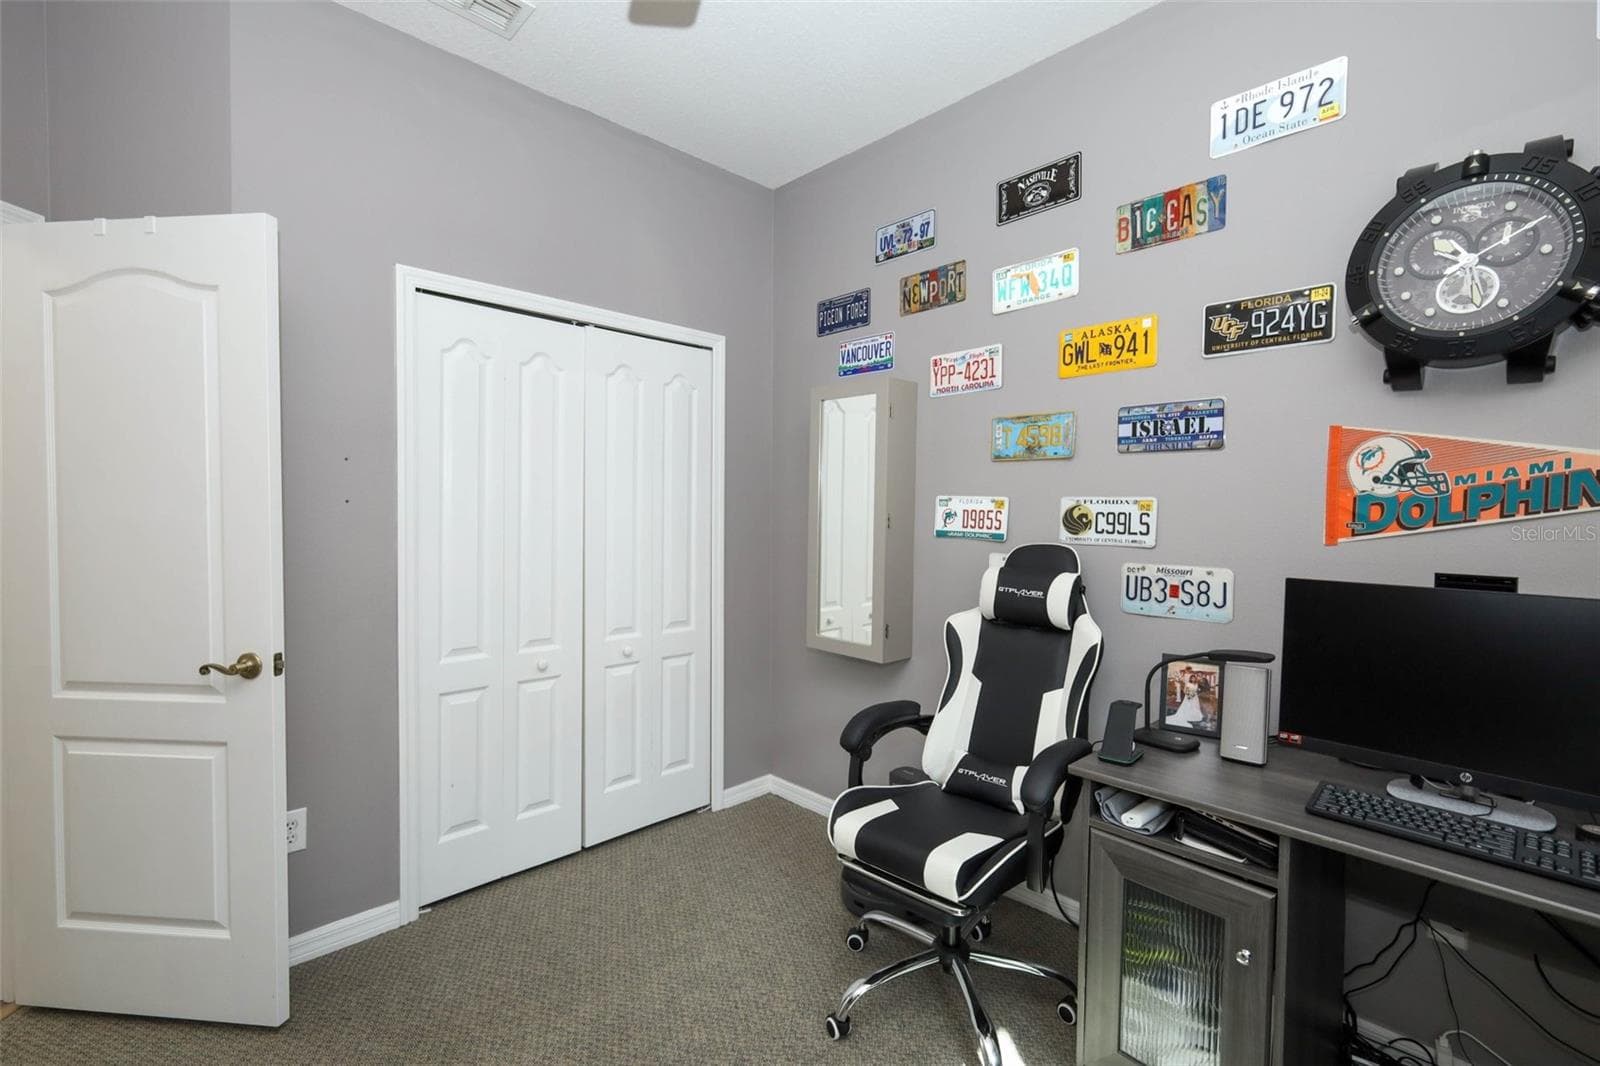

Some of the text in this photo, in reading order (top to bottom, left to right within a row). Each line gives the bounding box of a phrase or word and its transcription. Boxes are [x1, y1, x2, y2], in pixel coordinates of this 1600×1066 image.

[1241, 69, 1312, 104] Rhode Island
[1280, 77, 1334, 118] 972
[1243, 118, 1307, 145] Ocean State
[1017, 168, 1058, 196] NASHVILLE
[1166, 188, 1225, 232] EASY
[902, 271, 964, 311] NEWPORT
[1240, 294, 1293, 310] FLORIDA
[820, 307, 843, 328] PIGEON
[1210, 301, 1328, 340] UCF 924YG
[1081, 323, 1132, 340] ALASKA
[1211, 341, 1249, 352] UNIVERSITY
[1261, 335, 1290, 344] CENTRAL
[1292, 331, 1323, 340] FLORIDA
[840, 340, 892, 365] VANCOUVER
[1062, 330, 1149, 366] GWL 941
[933, 357, 996, 387] YPP-4231
[937, 380, 994, 395] NORTH CAROLINA
[1130, 416, 1211, 438] ISRAEL
[1454, 457, 1572, 487] MIAMI
[1156, 567, 1193, 576] Missouri
[998, 586, 1044, 599] GTPLAYER
[1126, 575, 1227, 609] UB3 S8J
[958, 768, 1008, 787] GTPLAYER
